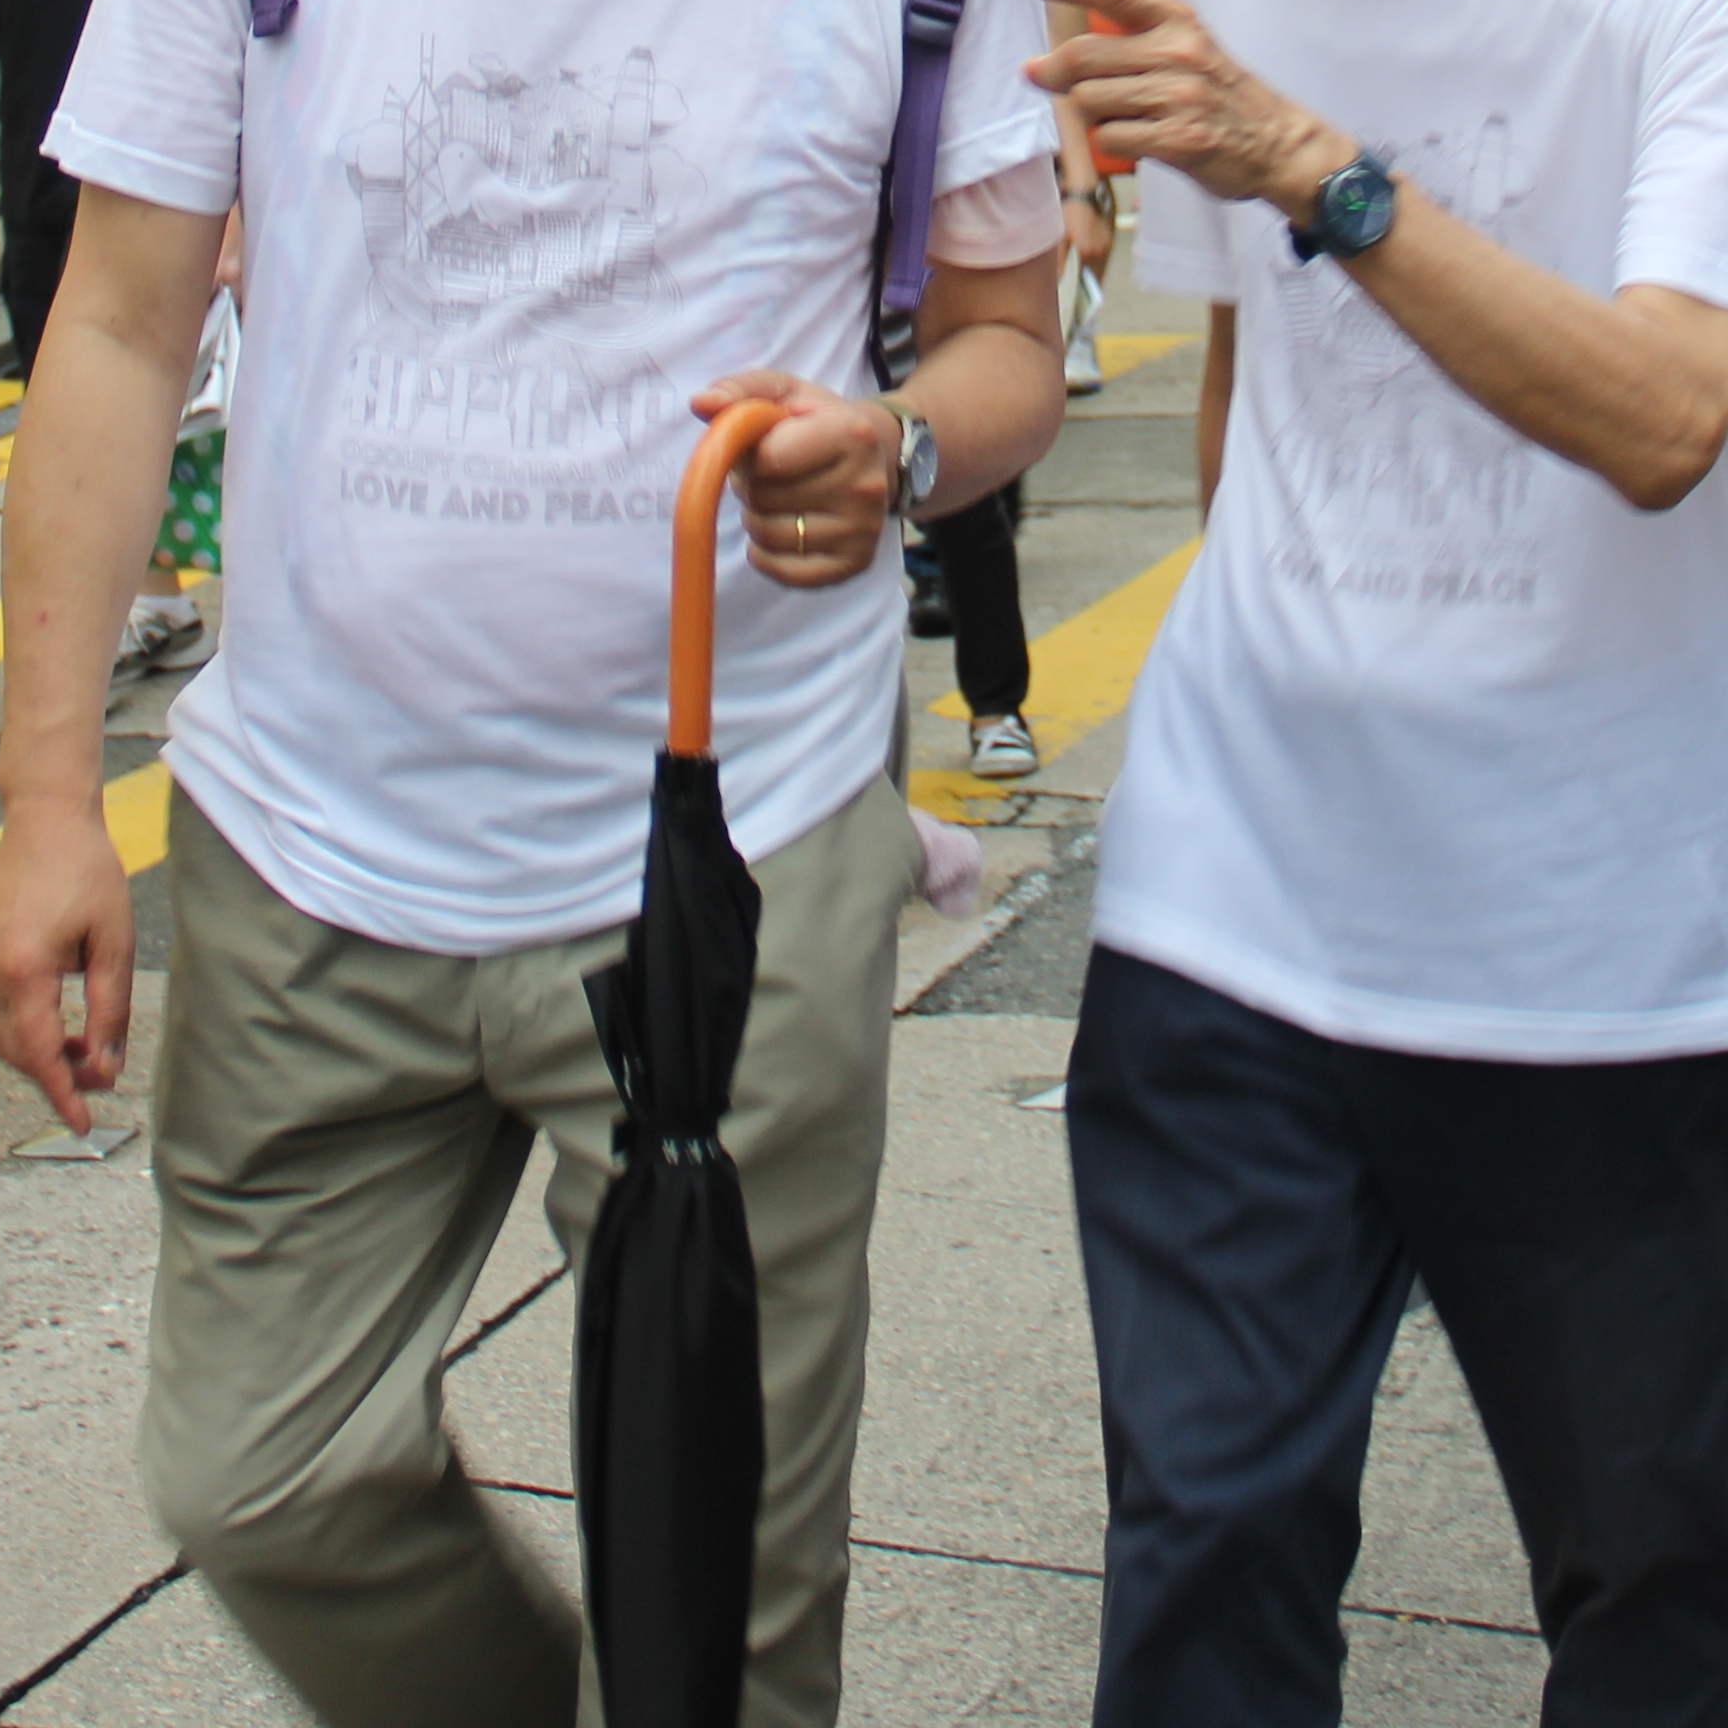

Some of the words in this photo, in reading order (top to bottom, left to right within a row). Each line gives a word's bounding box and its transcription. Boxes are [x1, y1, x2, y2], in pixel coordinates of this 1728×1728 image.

[339, 465, 429, 516] LOVE
[440, 482, 531, 524] AND
[544, 485, 676, 525] PEACE
